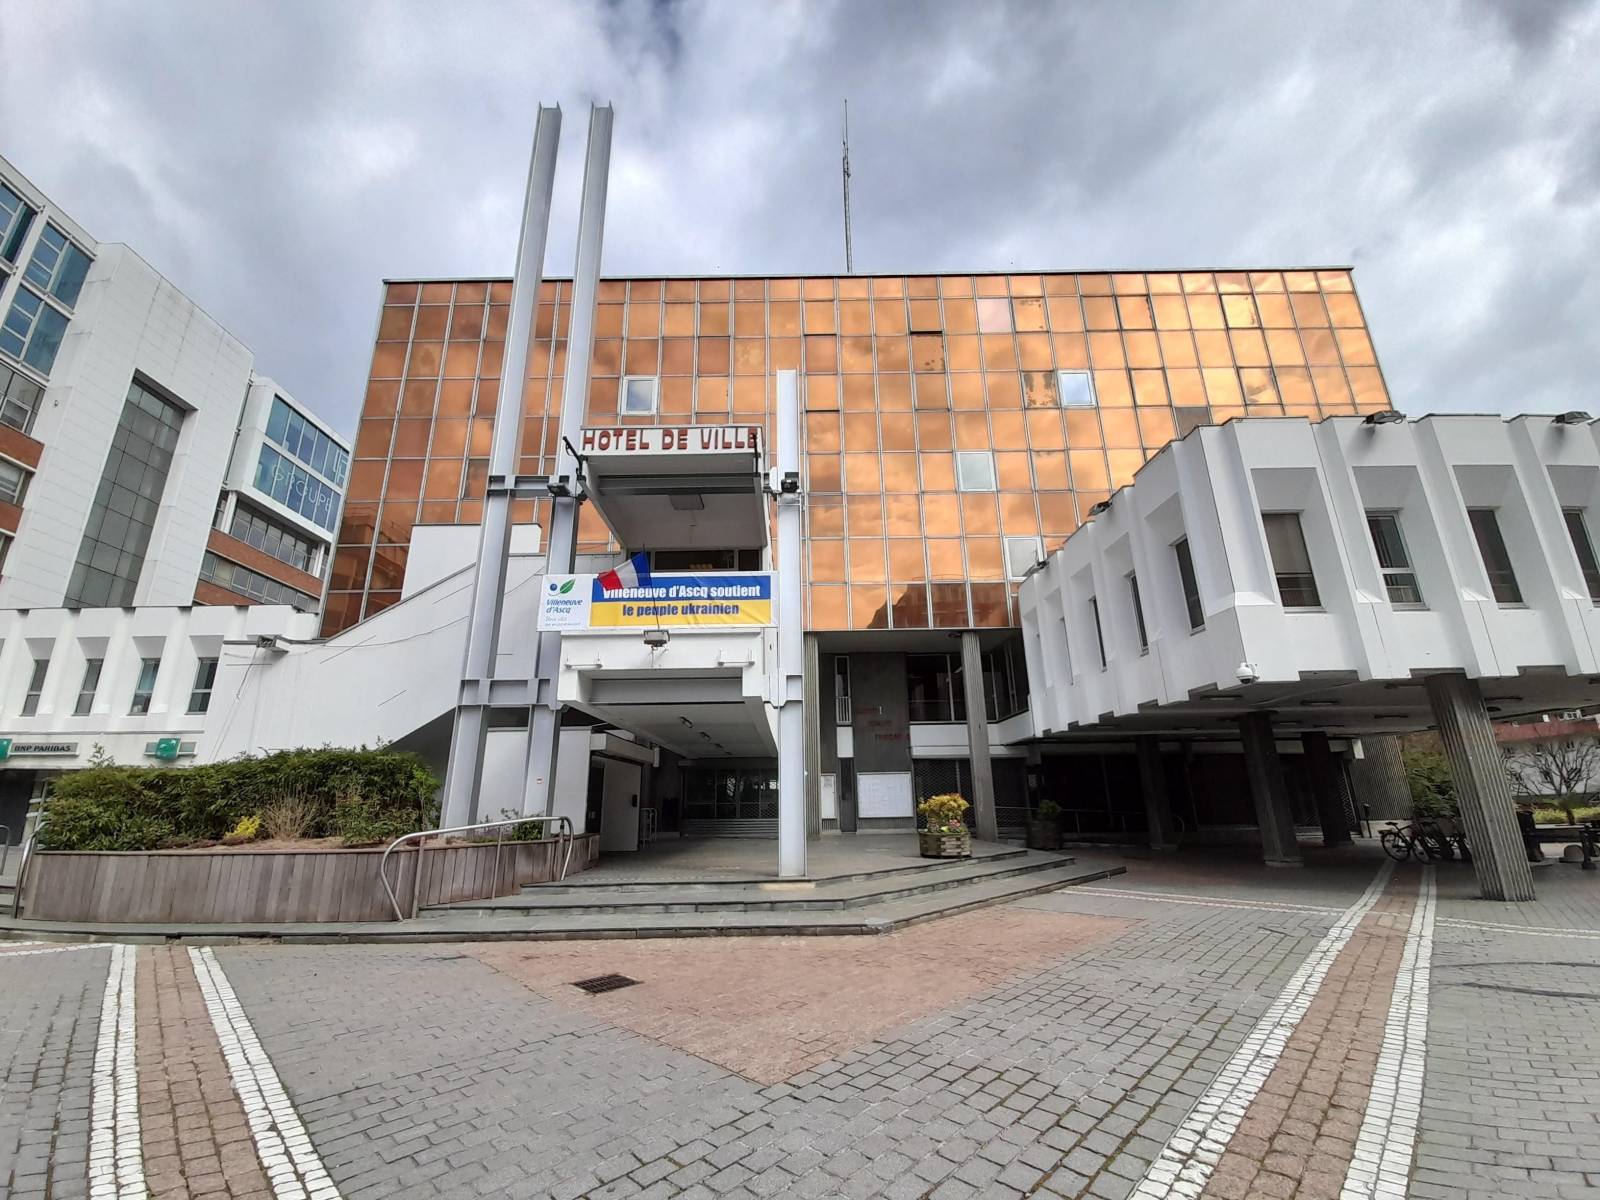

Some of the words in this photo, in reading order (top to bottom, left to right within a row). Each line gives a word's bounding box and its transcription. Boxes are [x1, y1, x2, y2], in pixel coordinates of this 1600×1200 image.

[582, 428, 650, 451] HOTEL
[661, 428, 689, 450] DE
[700, 426, 758, 450] VILLE
[668, 585, 708, 599] d'Ascq
[709, 585, 761, 598] soutient
[622, 604, 634, 616] le
[636, 604, 679, 617] peuple
[681, 603, 740, 615] ukrainien
